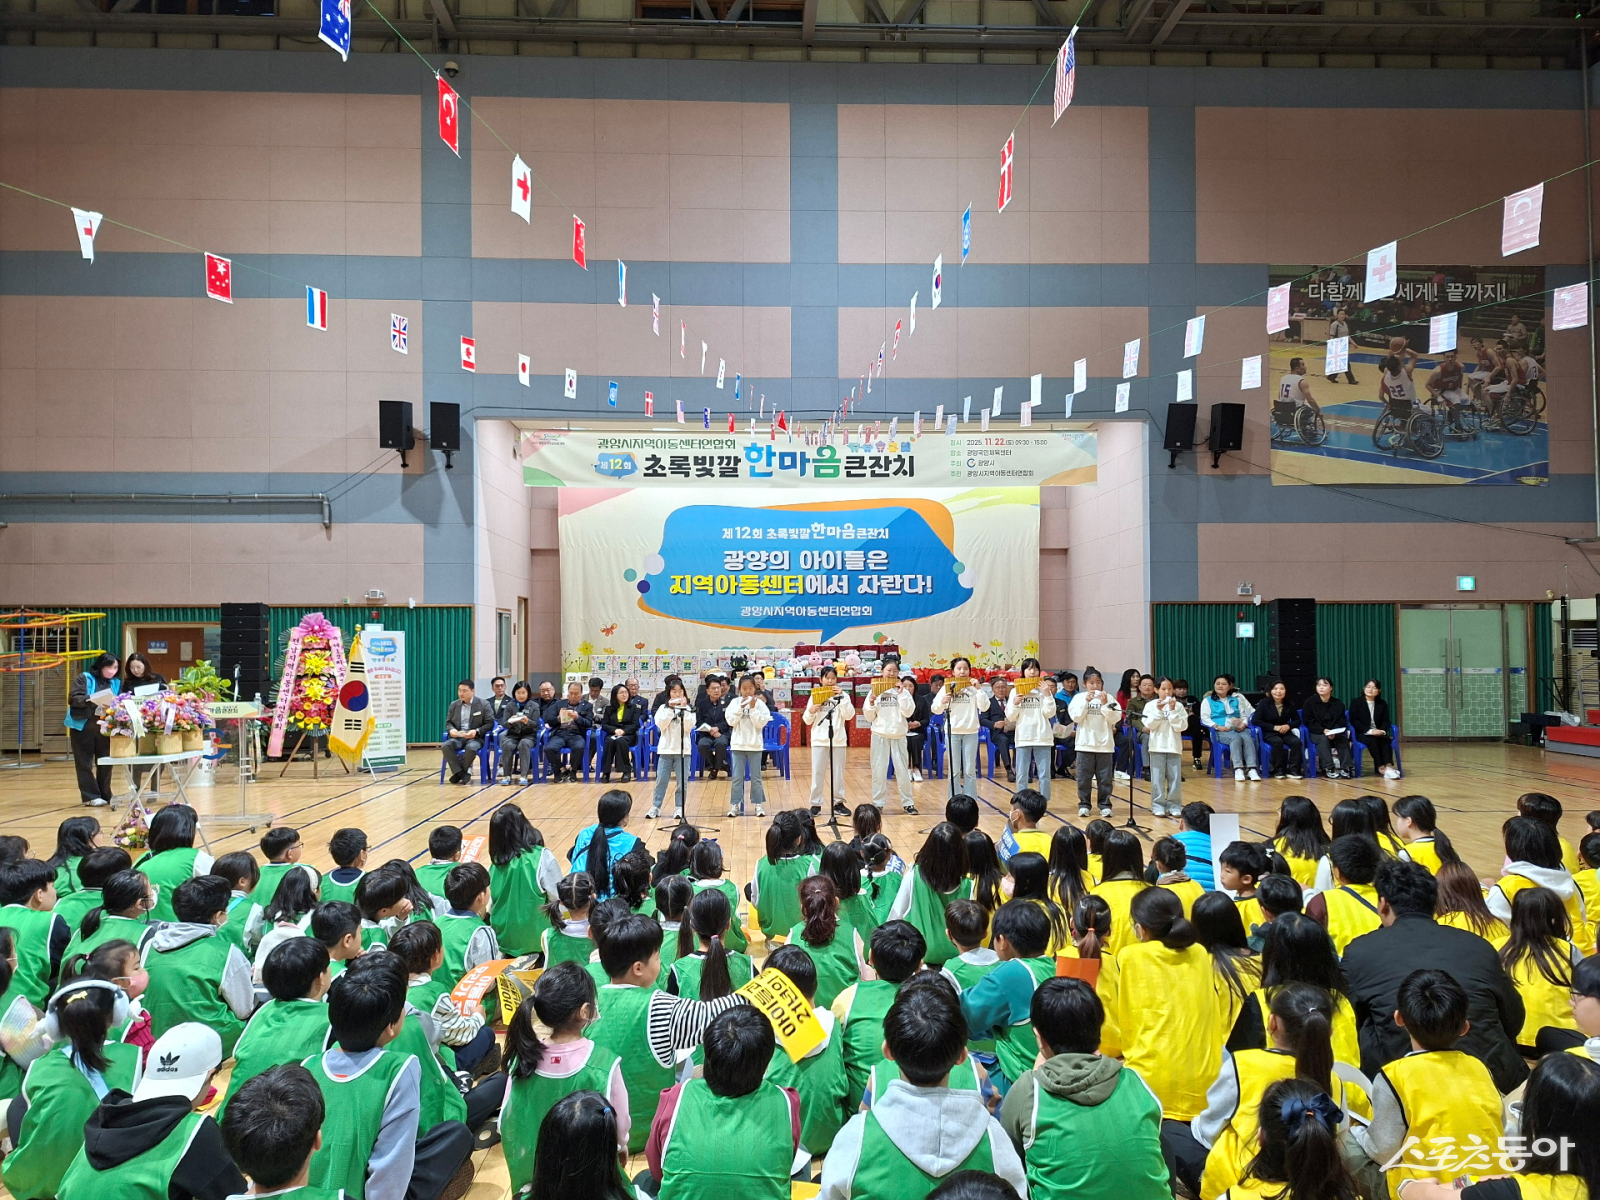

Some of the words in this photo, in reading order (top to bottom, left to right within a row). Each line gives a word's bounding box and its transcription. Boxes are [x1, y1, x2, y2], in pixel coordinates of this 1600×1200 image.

[1308, 281, 1364, 302] 다함께
[1381, 281, 1439, 302] 세게!
[1445, 281, 1507, 302] 끝까지!
[1280, 382, 1291, 398] 15
[1388, 383, 1406, 398] 22
[597, 438, 736, 450] 광양시지역아동센터연합회
[600, 458, 632, 471] 제12회
[643, 454, 742, 478] 초록빛깔
[844, 455, 915, 478] 큰잔치
[722, 526, 763, 540] 제12회
[856, 527, 889, 540] 큰잔치
[723, 550, 790, 571] 광양의
[799, 550, 889, 571] 아이들은
[669, 574, 850, 596] 지역아동센터에서
[857, 574, 933, 596] 자란다!
[740, 605, 873, 617] 광양시지역아동센터연합회
[767, 975, 812, 1024] 21년의
